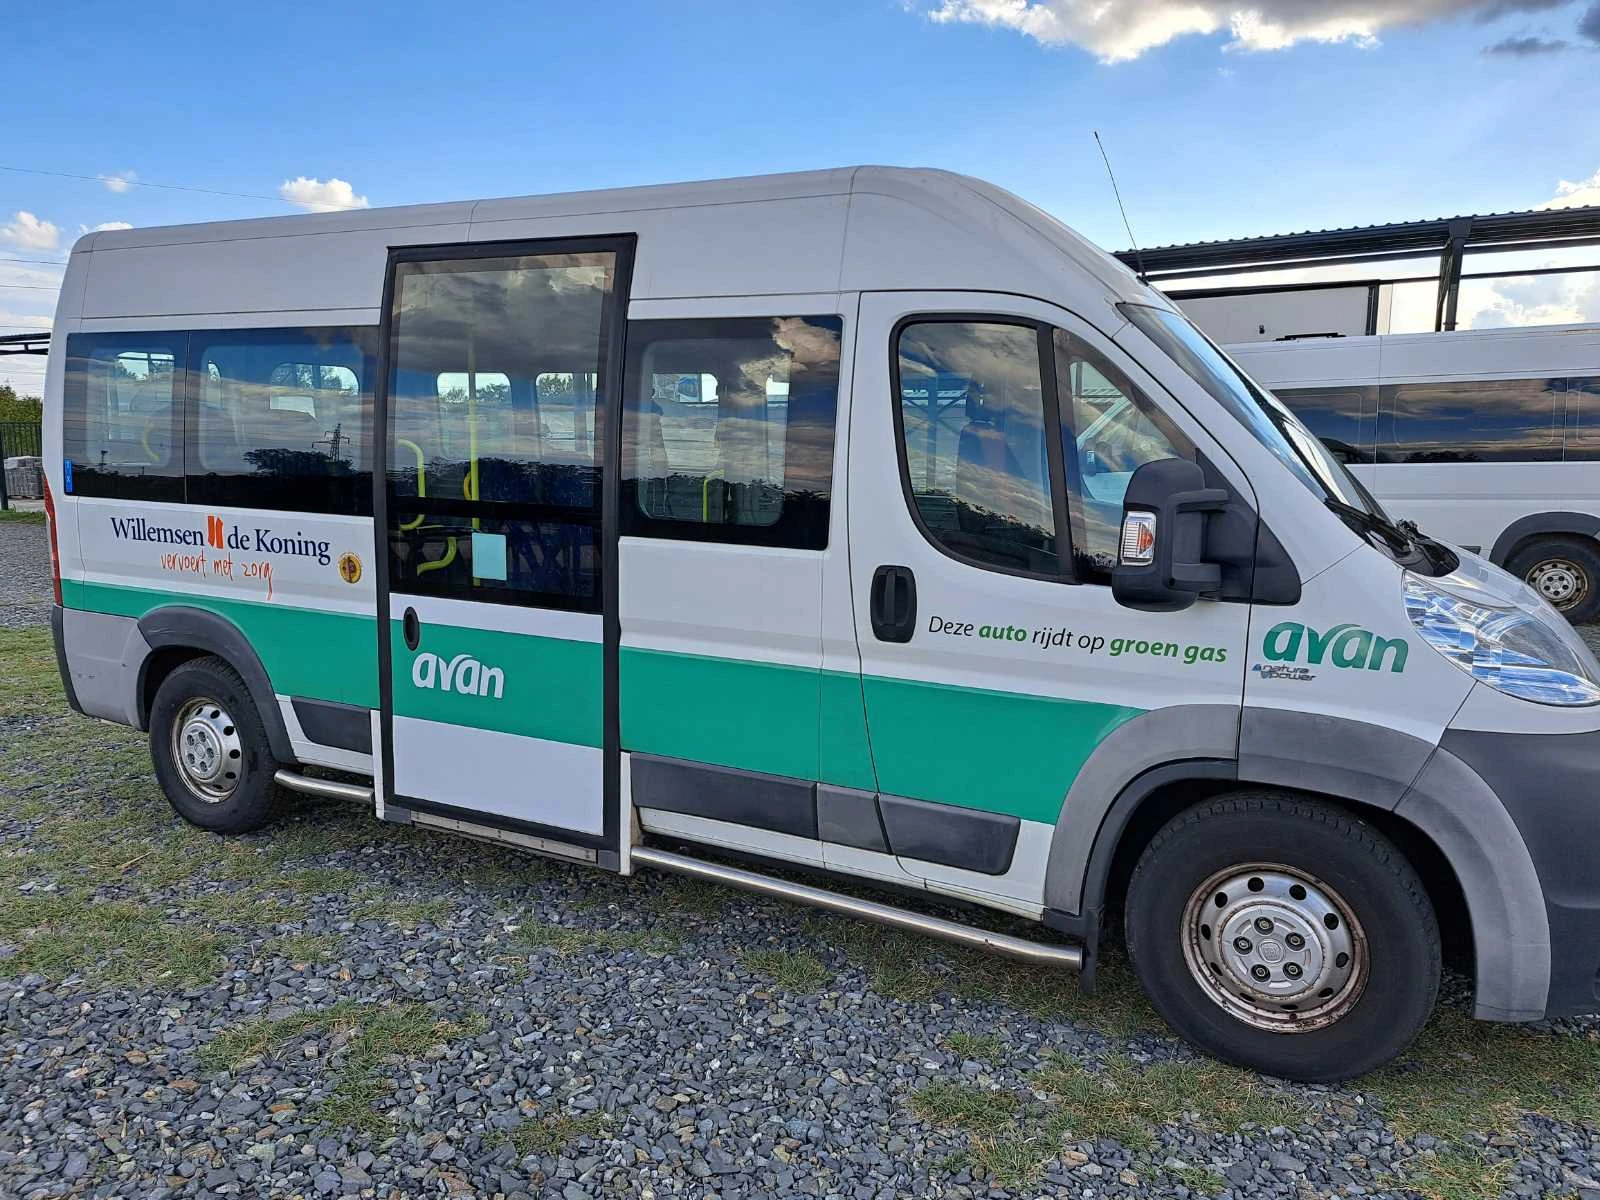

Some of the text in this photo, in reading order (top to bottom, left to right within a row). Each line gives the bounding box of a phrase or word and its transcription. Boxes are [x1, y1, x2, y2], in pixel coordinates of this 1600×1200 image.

[110, 517, 331, 566] Willemsen de Koning
[160, 548, 274, 600] vervoert met zorg
[928, 616, 1227, 665] Deze auto rijdt op groen gas
[1262, 621, 1409, 673] avan
[412, 652, 505, 699] avan
